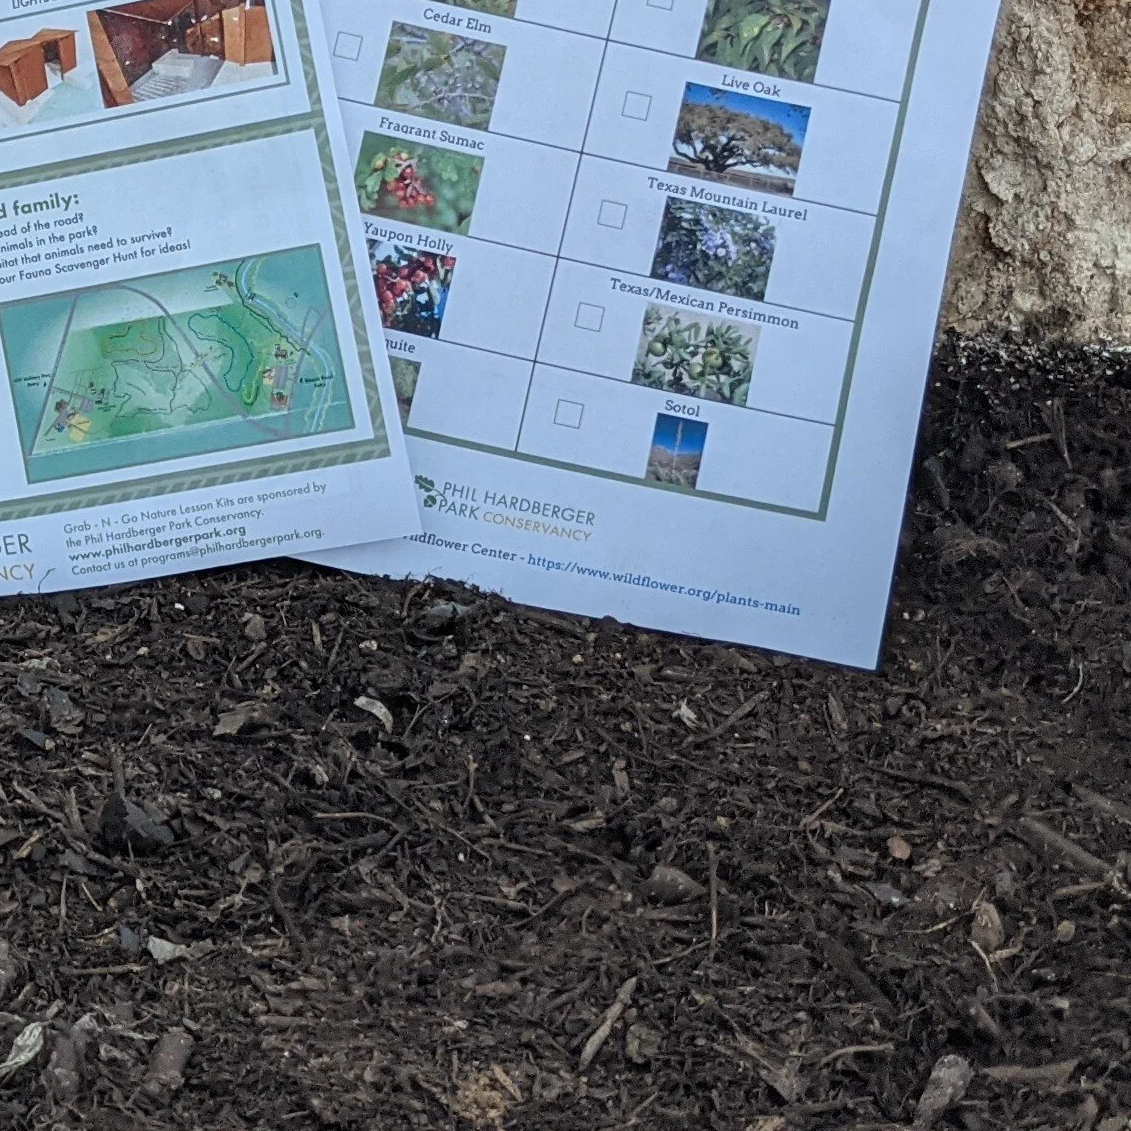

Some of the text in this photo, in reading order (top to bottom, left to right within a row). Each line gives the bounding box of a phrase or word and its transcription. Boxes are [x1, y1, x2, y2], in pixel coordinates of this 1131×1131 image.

[423, 8, 491, 33] Cedar Elm
[721, 74, 780, 97] Live Oak
[439, 130, 484, 150] Sumac
[12, 192, 79, 216] family:
[647, 176, 807, 221] Texas Mountain Laurel
[363, 221, 453, 254] Yaupon Holly
[610, 277, 798, 329] Texas/Mexican Persimmon
[664, 399, 700, 417] Sotol
[63, 520, 91, 533] Grab
[101, 517, 110, 527] N
[121, 513, 138, 524] Go
[140, 509, 176, 521] Nature
[179, 502, 213, 514] Lesson
[215, 497, 234, 508] Kits
[237, 496, 254, 504] are
[257, 483, 310, 503] sponsored
[312, 482, 326, 494] by
[437, 497, 591, 541] PARK CONSERVANCY
[441, 481, 594, 526] PHIL HARDBERGER
[66, 509, 264, 547] the Phil Hardberger Park Conservancy.
[68, 526, 246, 561] www.philhardbergerpark.org
[71, 529, 324, 575] Contact us at programs@philhardbergerpark.org.
[471, 543, 517, 561] Center
[527, 553, 800, 615] https://www.wildflower.org/plants-main
